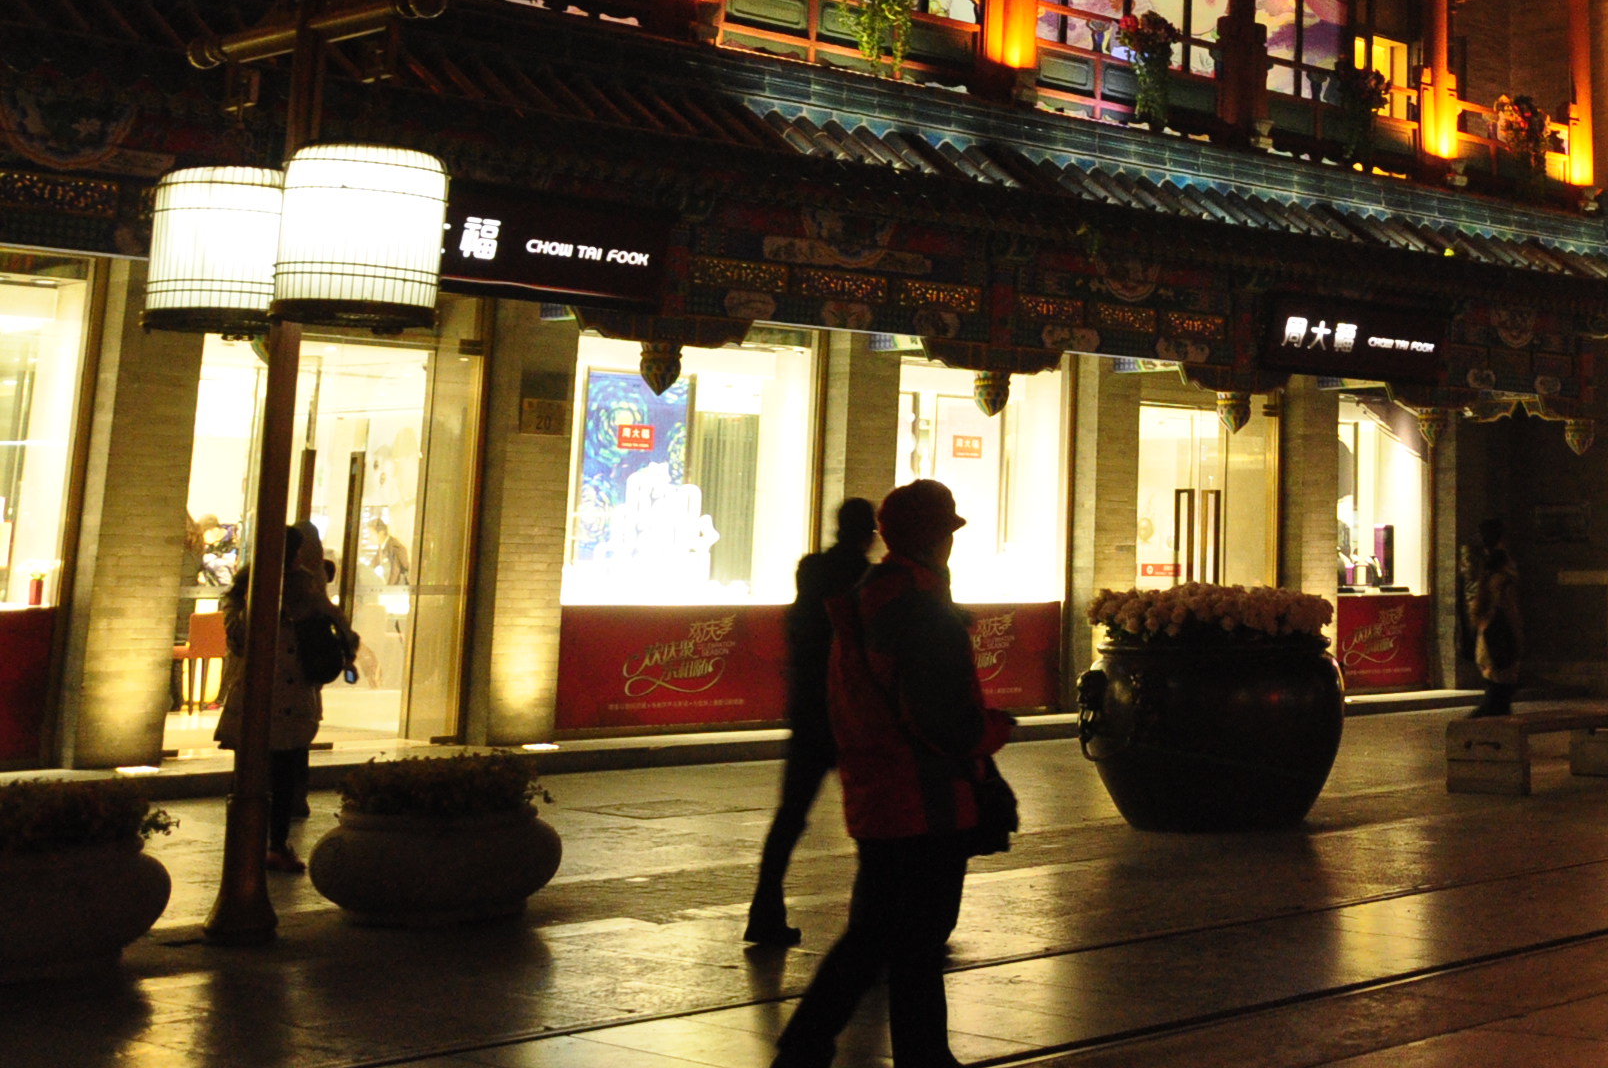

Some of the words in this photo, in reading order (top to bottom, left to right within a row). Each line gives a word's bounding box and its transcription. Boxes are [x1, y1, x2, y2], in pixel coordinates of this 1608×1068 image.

[526, 239, 574, 257] CHOW
[577, 245, 602, 261] TAI
[606, 249, 649, 266] FOOK
[1281, 316, 1358, 353] 周大福
